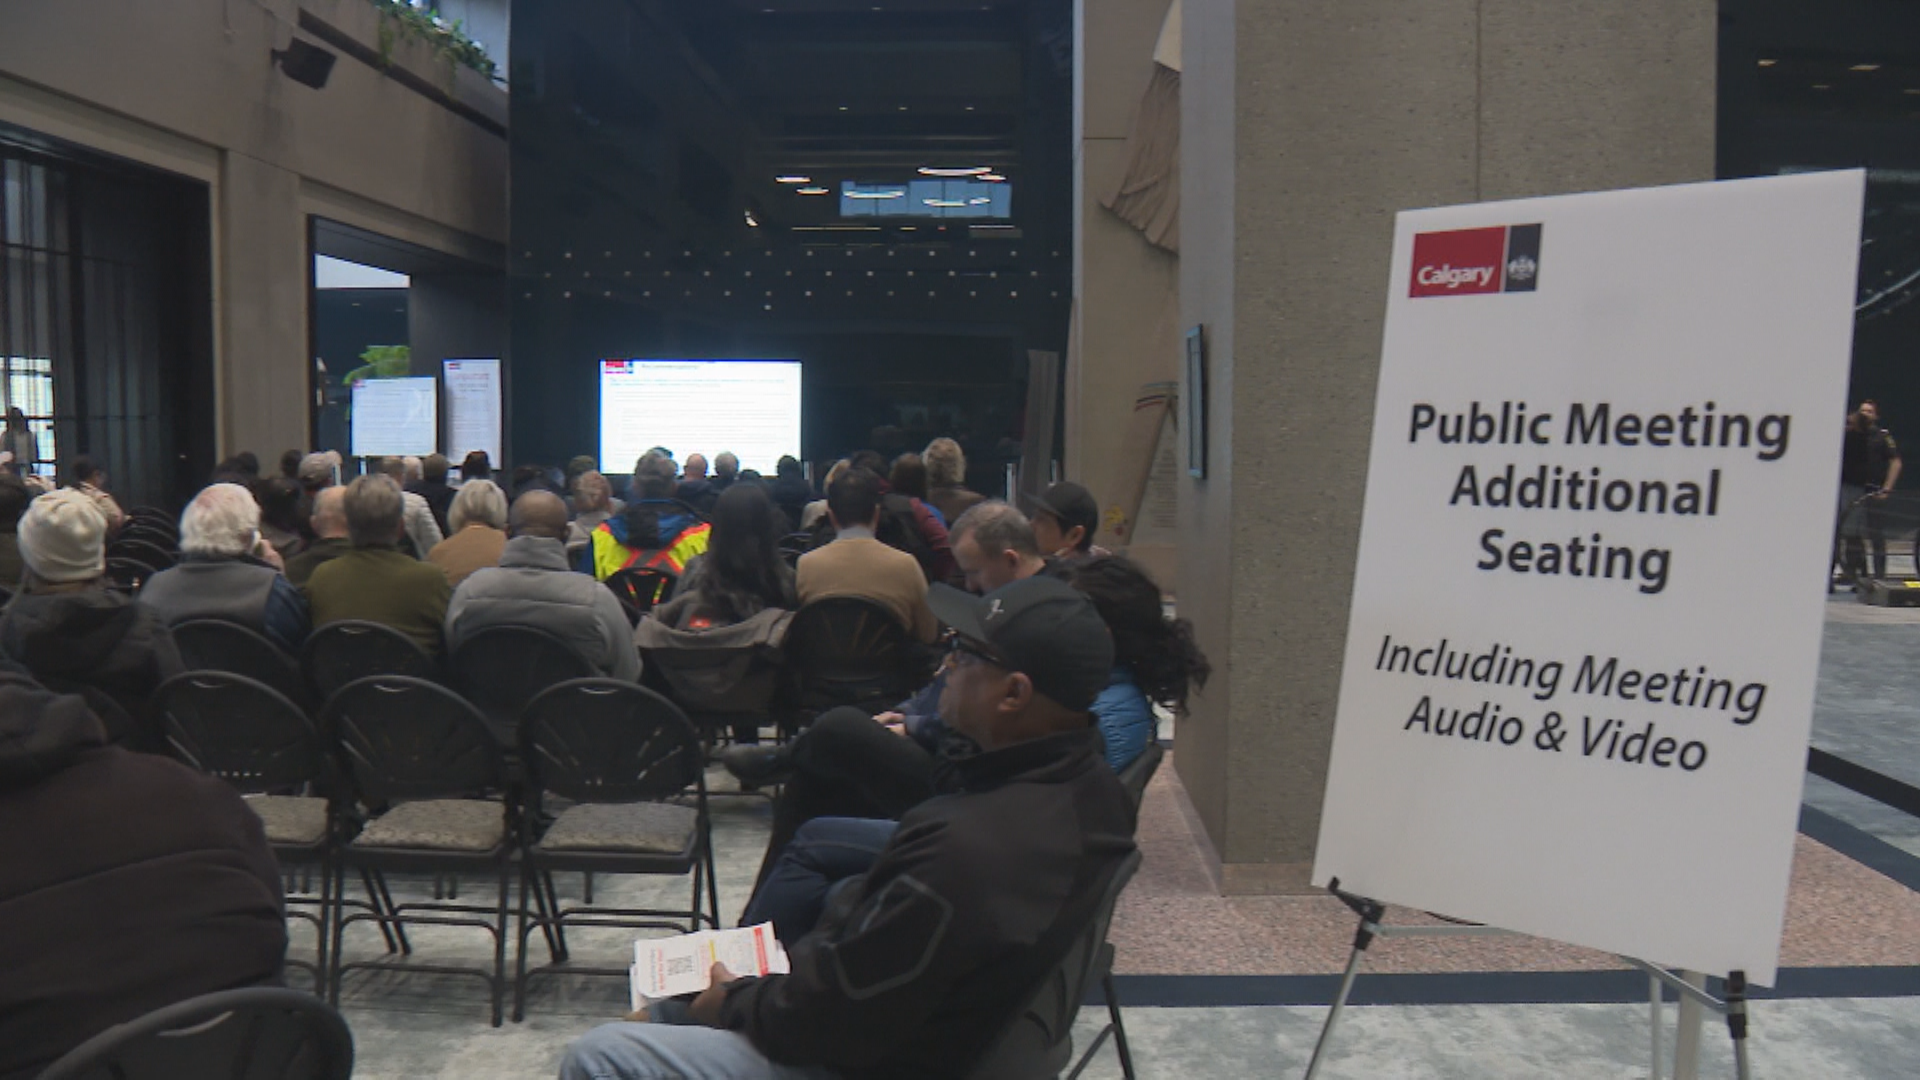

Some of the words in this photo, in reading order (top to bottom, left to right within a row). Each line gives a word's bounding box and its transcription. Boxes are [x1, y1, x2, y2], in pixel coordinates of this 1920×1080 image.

[1417, 263, 1495, 289] Calgary
[1408, 401, 1552, 446] Public
[1564, 401, 1791, 462] Meeting
[1448, 465, 1722, 517] Additional
[1476, 528, 1672, 595] Seating
[1375, 635, 1564, 701] Including
[1572, 655, 1768, 726] Meeting
[1404, 696, 1524, 746] Audio
[1534, 711, 1568, 753] &
[1581, 716, 1708, 772] Video
